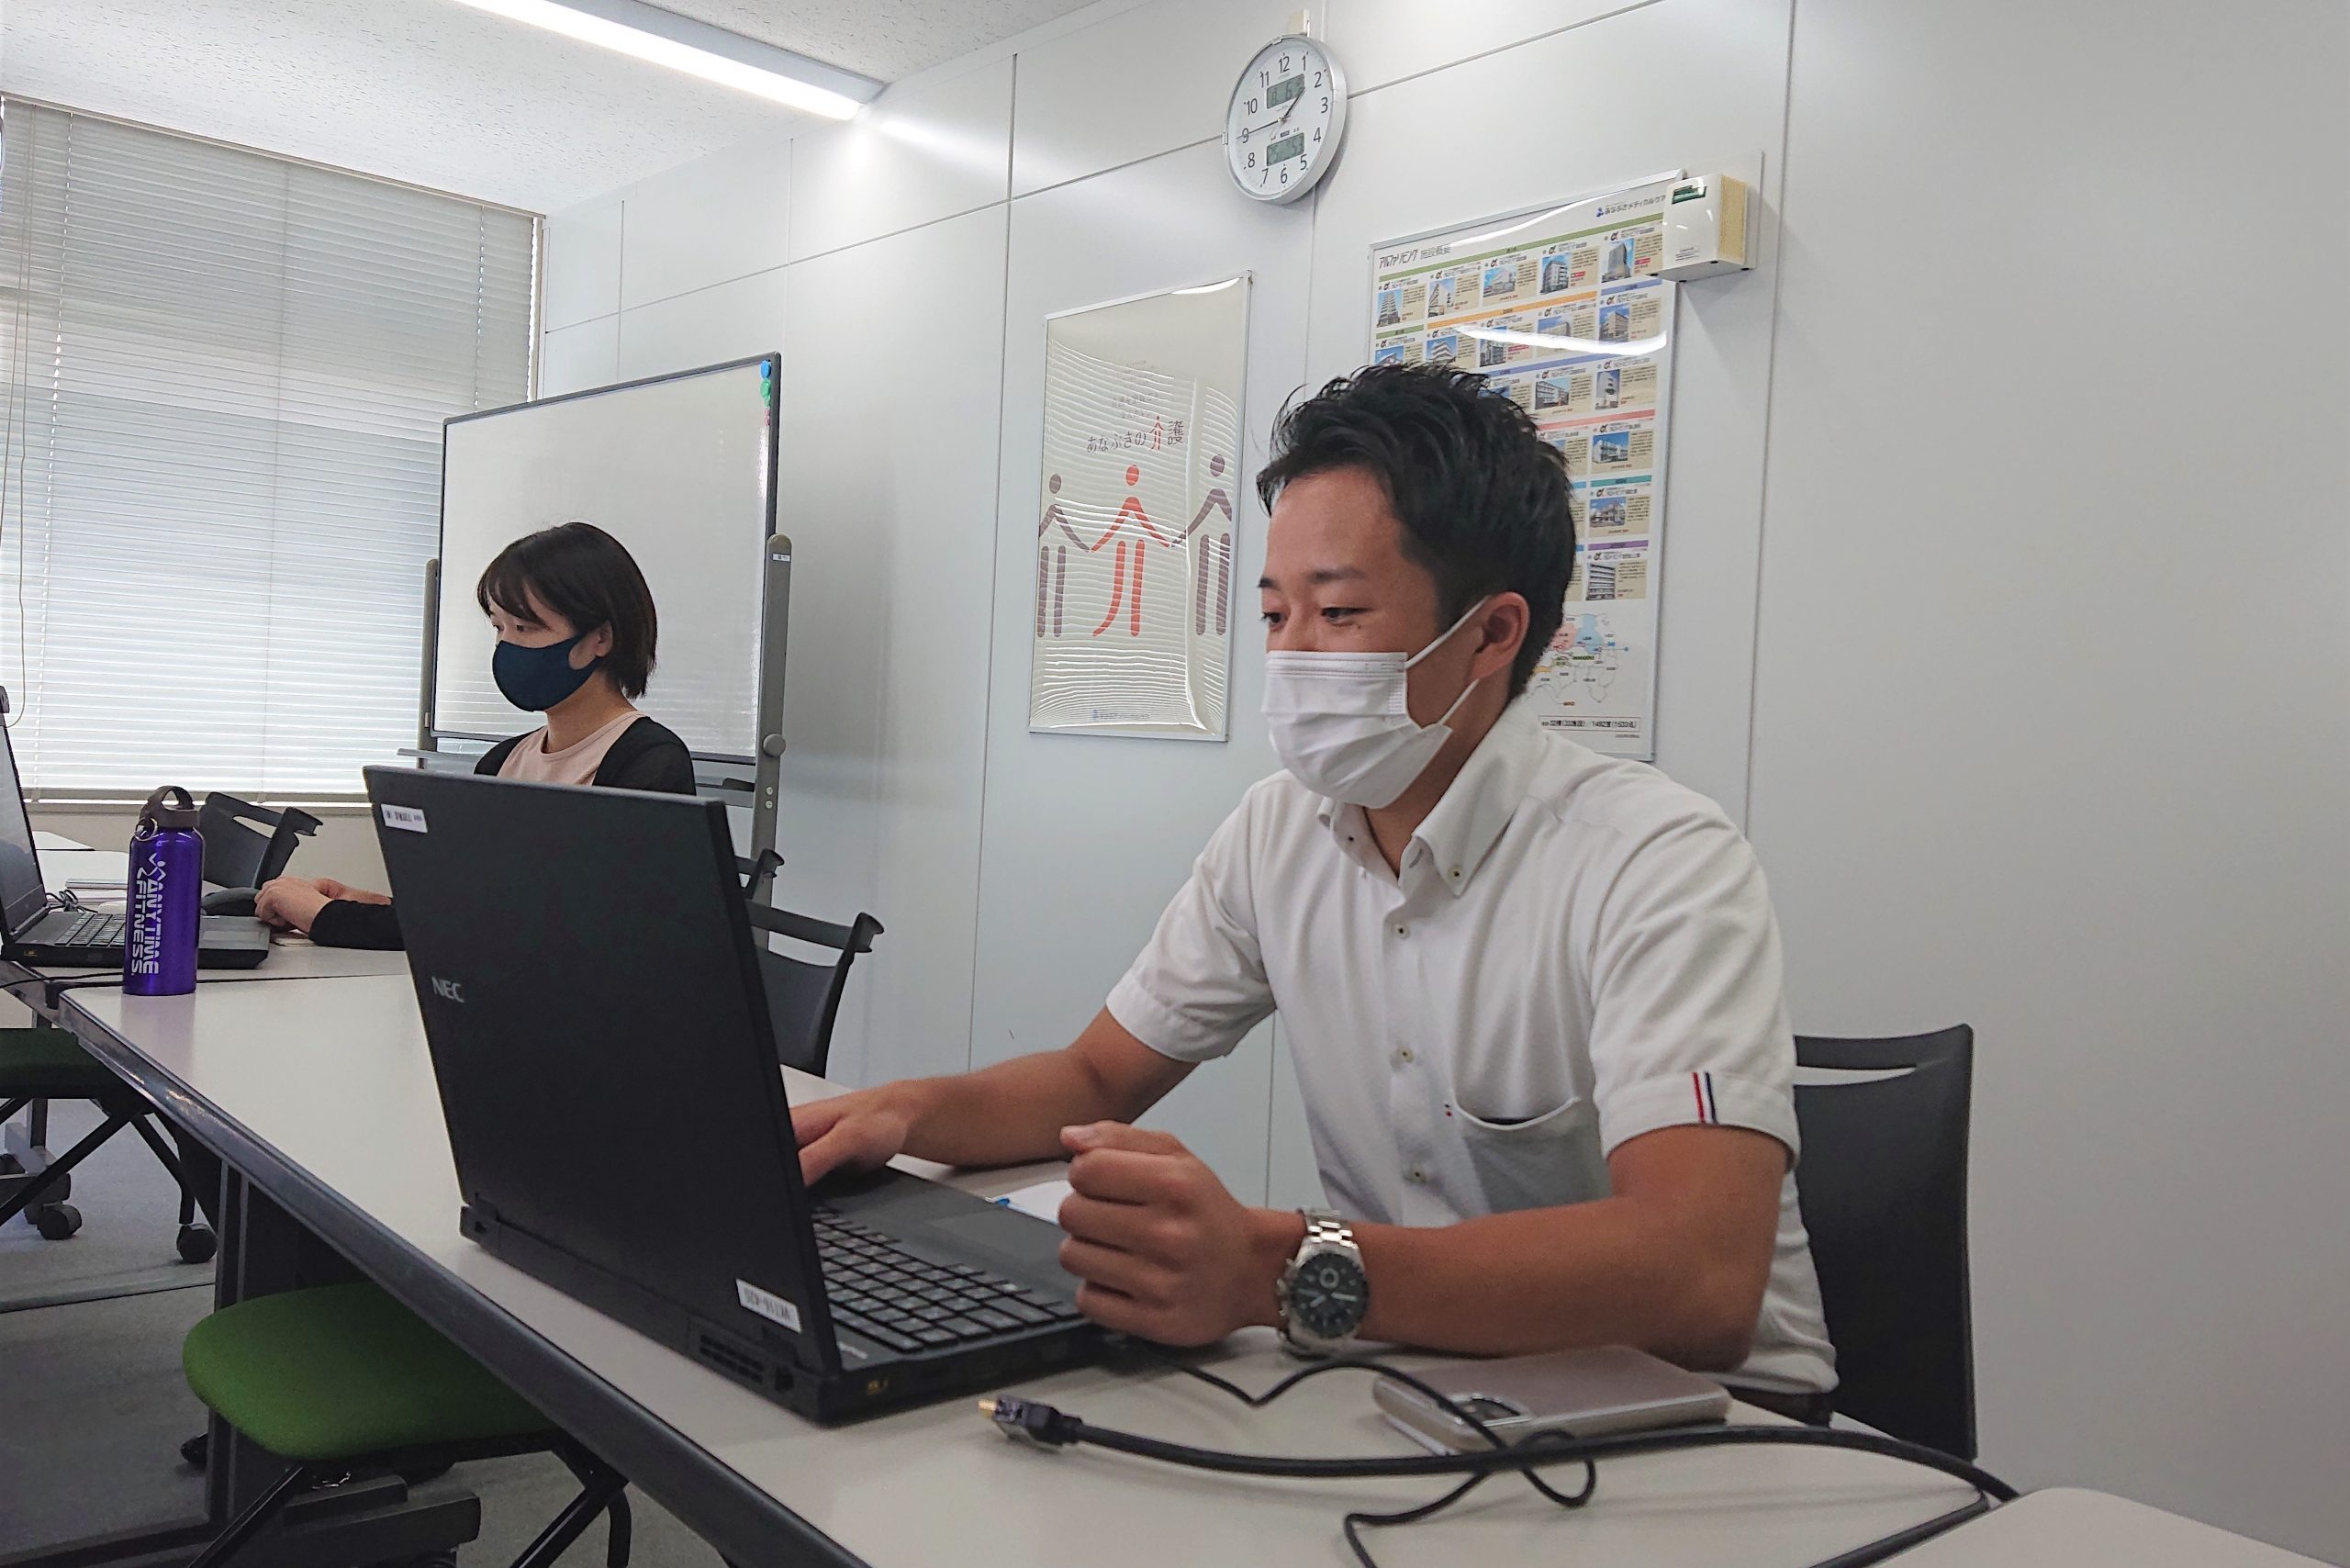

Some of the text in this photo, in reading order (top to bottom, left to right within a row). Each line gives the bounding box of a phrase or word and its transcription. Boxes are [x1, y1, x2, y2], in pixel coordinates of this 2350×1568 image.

[1278, 55, 1290, 73] 12
[1302, 55, 1307, 71] 1
[1259, 71, 1270, 88] 11
[1314, 71, 1322, 88] 2
[1246, 97, 1258, 116] 10
[1320, 96, 1328, 114] 3
[1241, 128, 1249, 144] 9
[1313, 127, 1321, 143] 4
[1248, 151, 1256, 168] 8
[1300, 153, 1307, 172] 5
[1261, 168, 1270, 185] 7
[1280, 166, 1288, 185] 6
[131, 879, 147, 975] FITNESS
[142, 879, 163, 974] ANYTIME
[431, 976, 465, 1003] NEC
